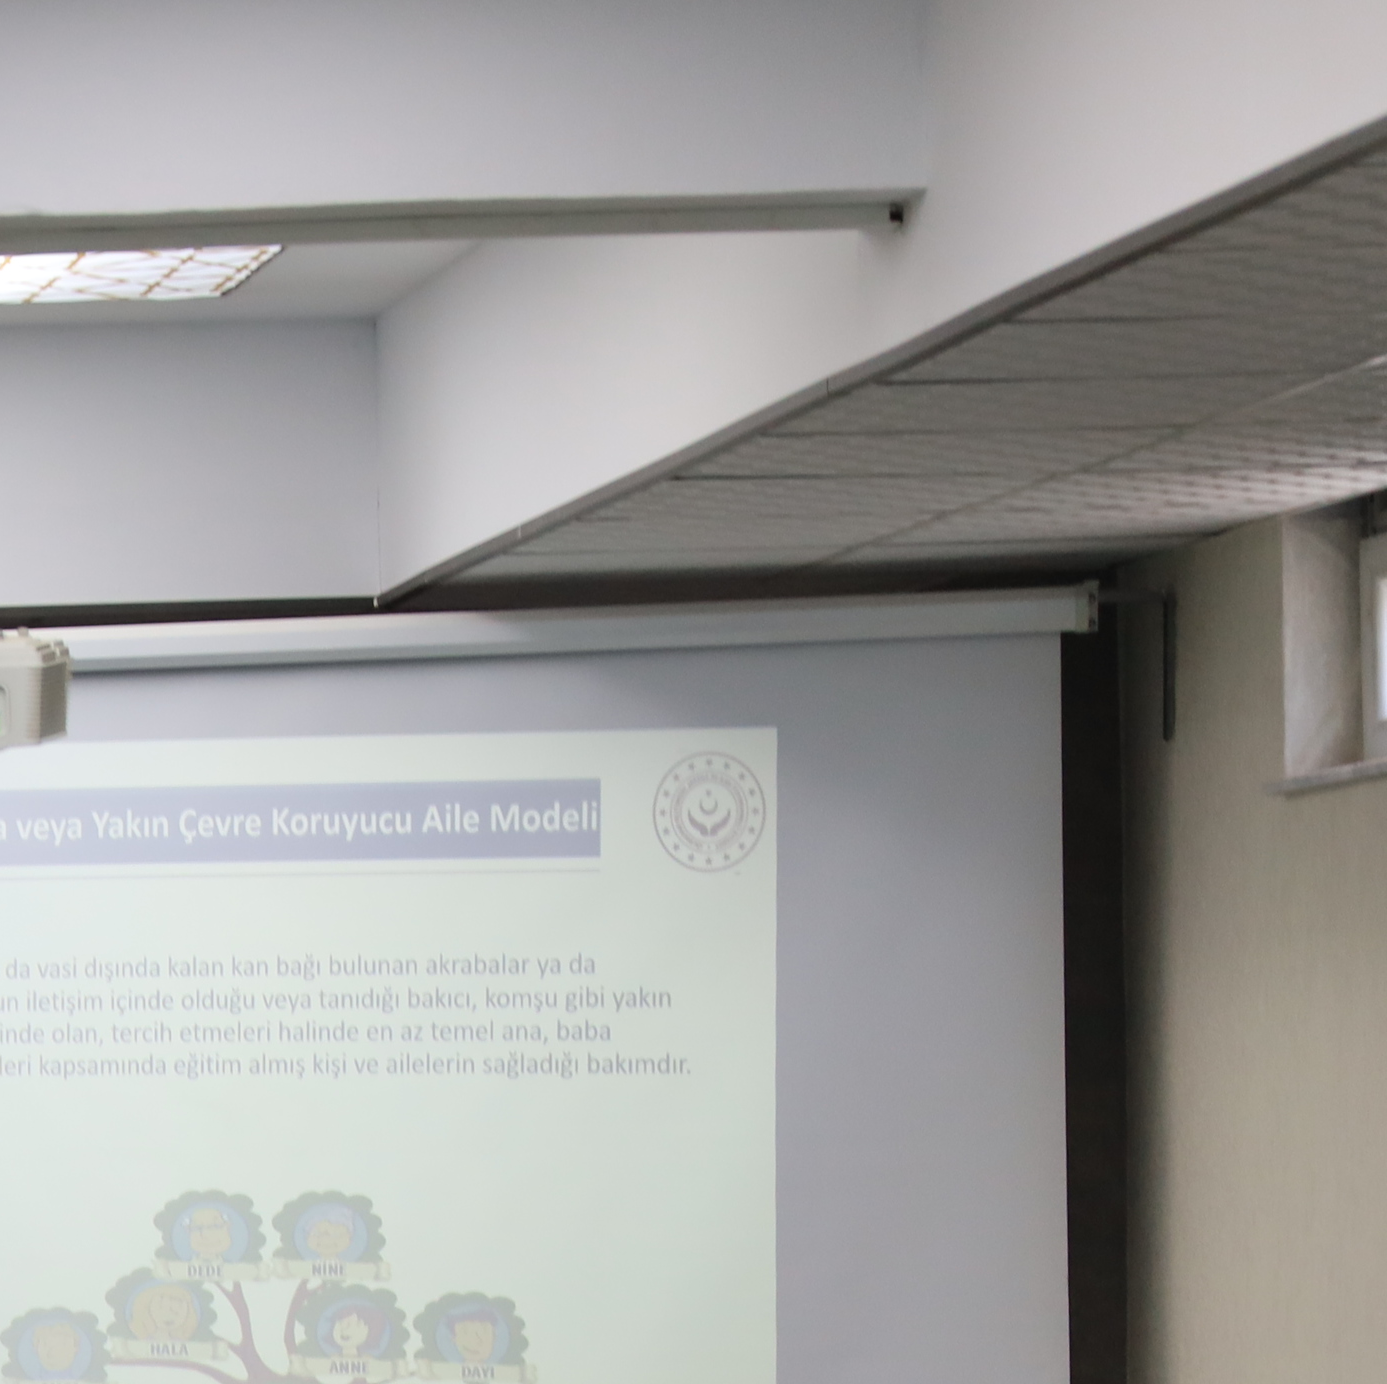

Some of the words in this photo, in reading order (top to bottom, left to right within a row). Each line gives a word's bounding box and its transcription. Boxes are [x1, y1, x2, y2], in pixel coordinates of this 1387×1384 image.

[16, 816, 82, 846] veya
[90, 811, 170, 840] Yakın
[179, 808, 262, 843] Çevre
[271, 809, 413, 840] Koruyucu
[421, 805, 480, 834] Aile
[490, 802, 599, 833] Modeli
[5, 959, 30, 979] da
[37, 957, 77, 978] vasi
[84, 956, 160, 983] dışında
[168, 955, 224, 978] kalan
[231, 955, 269, 977] kan
[277, 953, 321, 982] bağı
[329, 954, 418, 976] bulunan
[425, 952, 530, 975] akrabalar
[538, 958, 561, 980] ya
[568, 953, 595, 975] da
[26, 989, 103, 1017] iletişim
[110, 989, 174, 1015] içinde
[181, 988, 256, 1015] olduğu
[262, 992, 311, 1014] veya
[319, 987, 400, 1013] tanıdığı
[408, 988, 477, 1012] bakıcı,
[485, 987, 557, 1013] komşu
[565, 987, 605, 1012] gibi
[612, 986, 672, 1012] yakın
[51, 1023, 103, 1046] olan,
[111, 1021, 172, 1043] tercih
[180, 1021, 271, 1042] etmeleri
[278, 1019, 359, 1042] halinde
[367, 1026, 393, 1041] en
[401, 1026, 422, 1041] az
[431, 1021, 494, 1042] temel
[502, 1025, 548, 1044] ana,
[557, 1019, 611, 1041] baba
[39, 1053, 164, 1080] kapsamında
[173, 1052, 241, 1080] eğitim
[249, 1052, 305, 1078] almış
[313, 1054, 347, 1078] kişi
[354, 1058, 379, 1074] ve
[386, 1052, 475, 1074] ailelerin
[483, 1052, 578, 1080] sağladığı
[587, 1052, 691, 1075] bakımdır.
[150, 1343, 189, 1356] HALA
